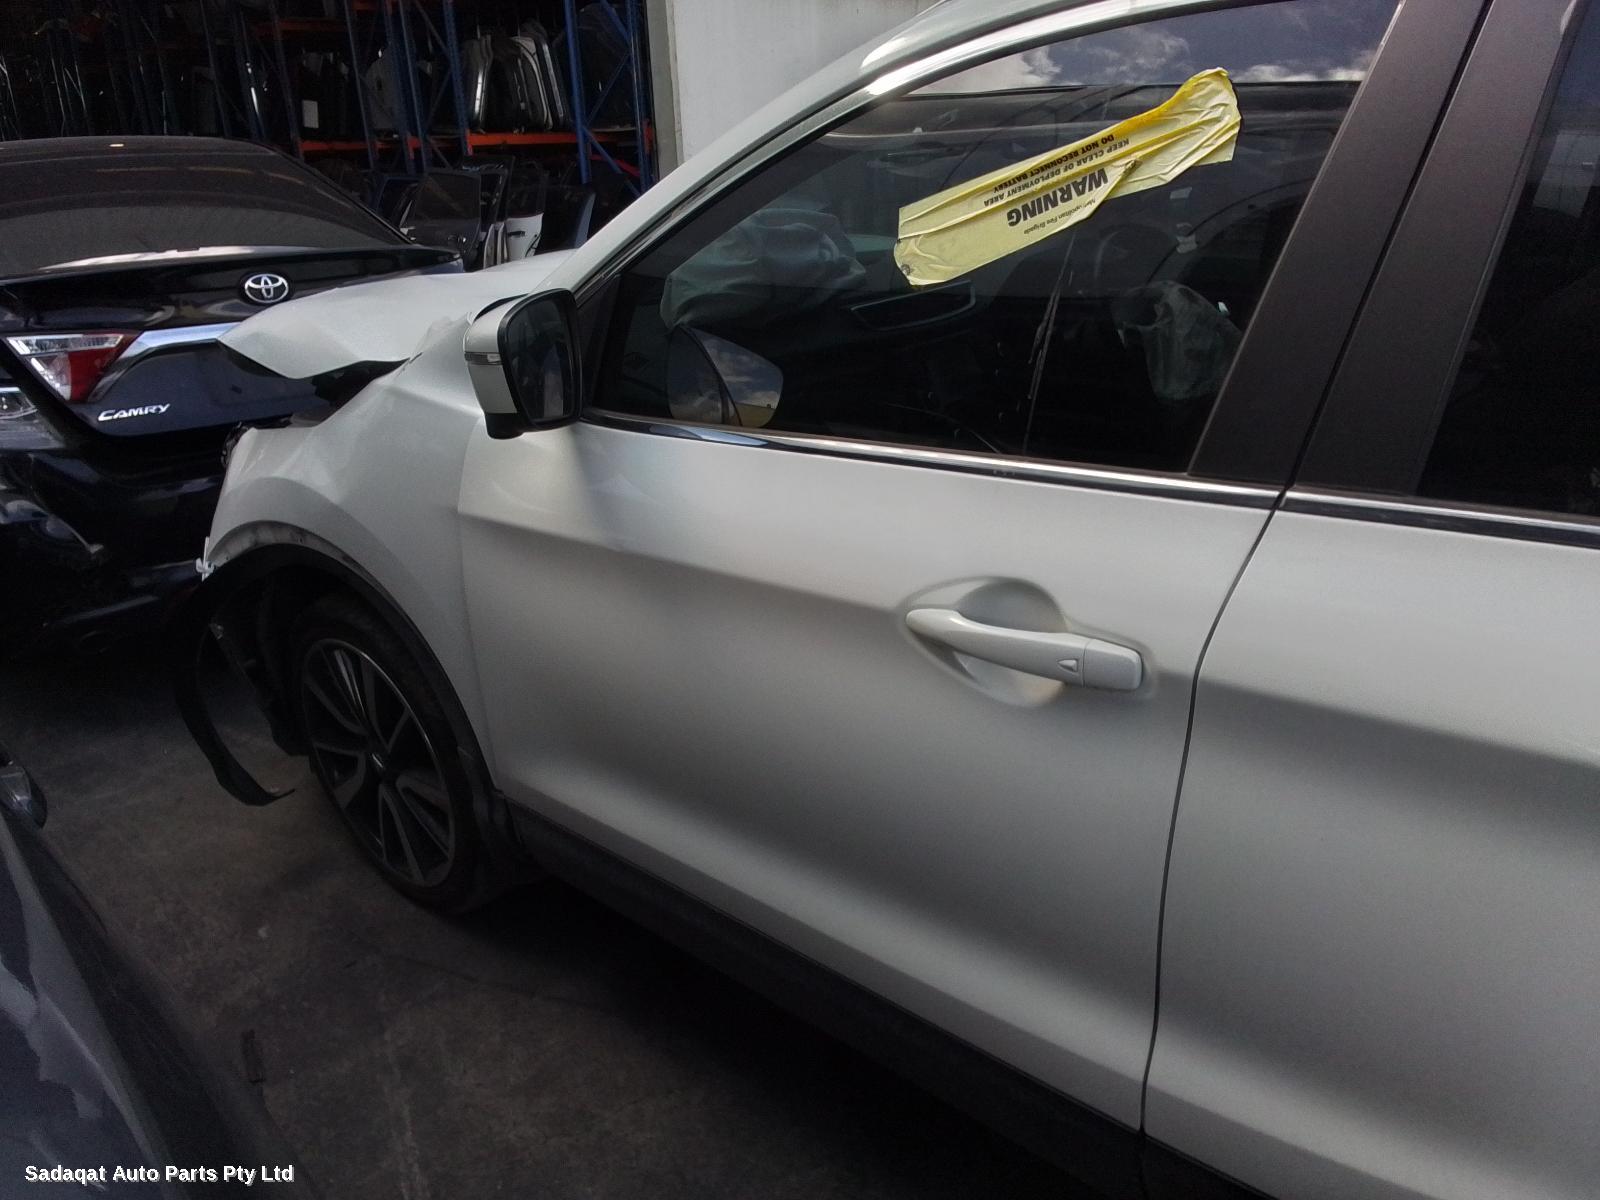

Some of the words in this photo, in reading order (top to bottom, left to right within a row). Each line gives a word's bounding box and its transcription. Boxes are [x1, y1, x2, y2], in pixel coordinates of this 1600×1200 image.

[1101, 134, 1115, 145] DO
[1106, 138, 1130, 152] KEEP
[1081, 142, 1099, 154] NOT
[1030, 151, 1079, 177] RECONNECT
[1076, 150, 1105, 166] CLEAR
[1062, 164, 1075, 173] OF
[993, 170, 1027, 193] BATTERY
[1006, 170, 1061, 197] DEPLOYMENT
[983, 193, 1005, 207] AREA
[1006, 168, 1108, 227] WARNING
[1023, 221, 1046, 235] Brigade
[1046, 217, 1058, 225] Fire
[98, 403, 171, 421] CAMRY
